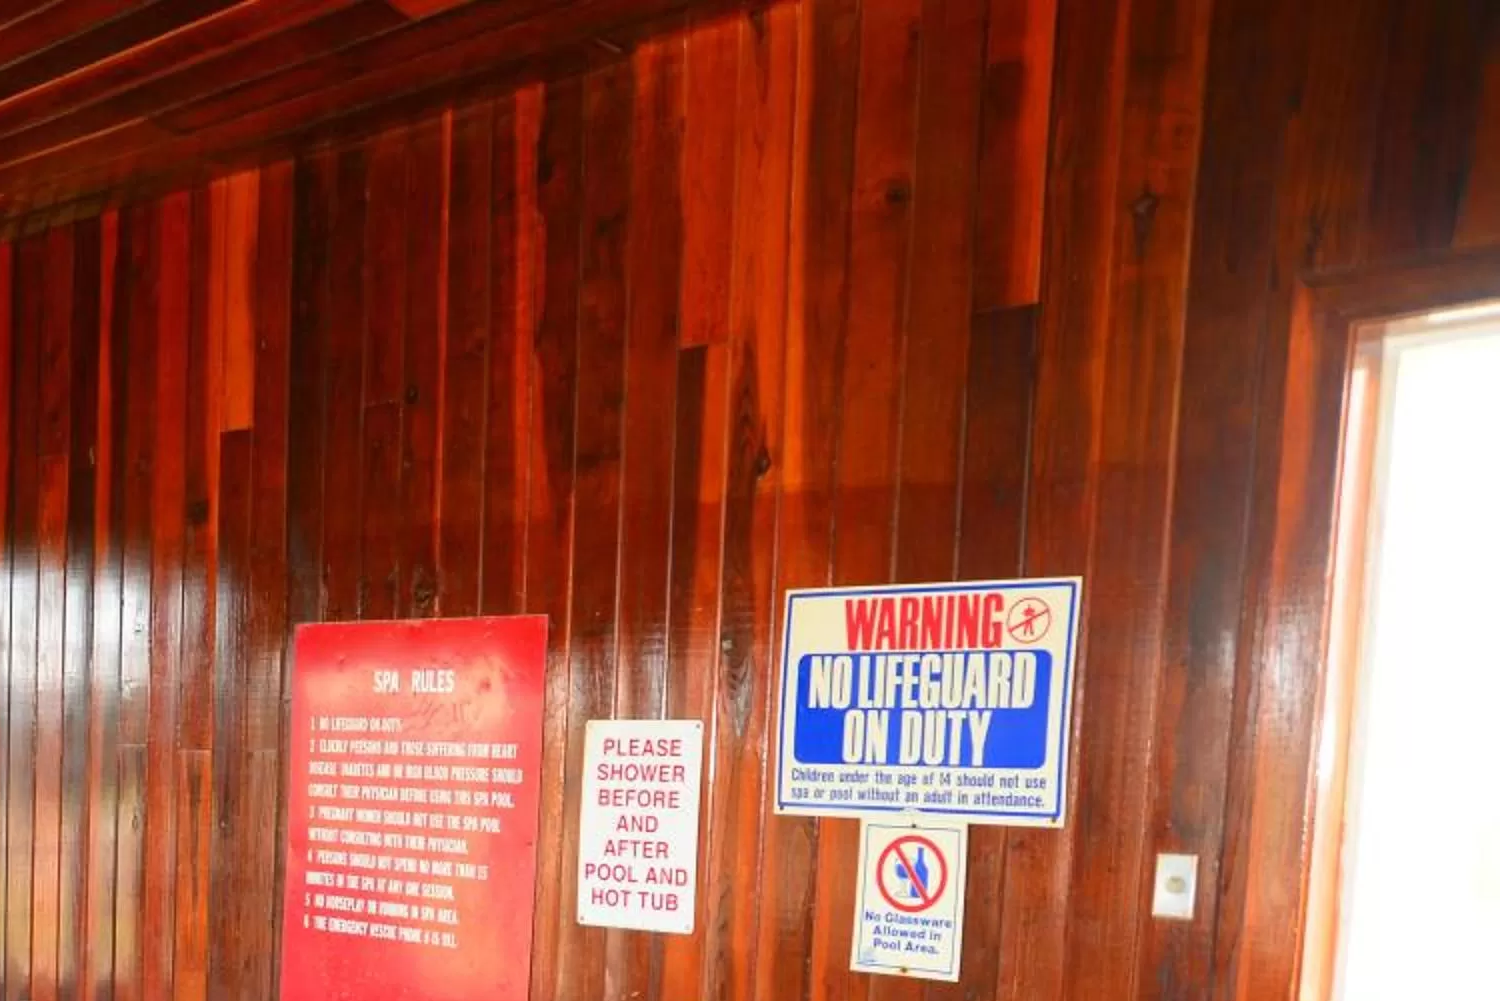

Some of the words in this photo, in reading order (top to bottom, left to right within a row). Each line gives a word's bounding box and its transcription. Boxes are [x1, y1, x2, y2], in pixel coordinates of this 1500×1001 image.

[845, 593, 1005, 651] WARNING
[373, 670, 400, 693] SPA
[411, 669, 455, 693] RULES
[807, 655, 853, 710] NO
[858, 651, 1038, 709] LIFEGUARD
[603, 738, 682, 757] PLEASE
[842, 709, 889, 764] ON
[898, 709, 993, 767] DUTY
[597, 764, 685, 782] SHOWER
[792, 768, 834, 783] Children
[840, 770, 869, 784] under
[876, 771, 893, 785] the
[898, 773, 917, 787] age
[922, 773, 934, 785] of
[940, 773, 951, 786] 14
[957, 773, 995, 788] should
[999, 774, 1019, 789] not
[1025, 777, 1046, 790] use
[473, 791, 488, 806] SPA
[598, 789, 680, 808] BEFORE
[792, 788, 809, 800] spa
[814, 789, 825, 799] or
[830, 788, 853, 802] pool
[858, 788, 899, 803] without
[906, 791, 918, 802] an
[924, 791, 952, 804] adult
[957, 792, 968, 805] in
[974, 793, 1045, 808] attendance.
[463, 815, 478, 831] SPA
[616, 815, 659, 833] AND
[604, 839, 669, 858] AFTER
[585, 863, 638, 883] POOL
[645, 867, 688, 887] AND
[592, 888, 631, 907] HOT
[637, 891, 679, 911] TUB
[865, 911, 881, 922] No
[885, 912, 952, 928] Glassware
[873, 925, 926, 939] Allowed
[930, 929, 942, 941] in
[873, 938, 901, 951] Pool
[906, 941, 940, 955] Area.
